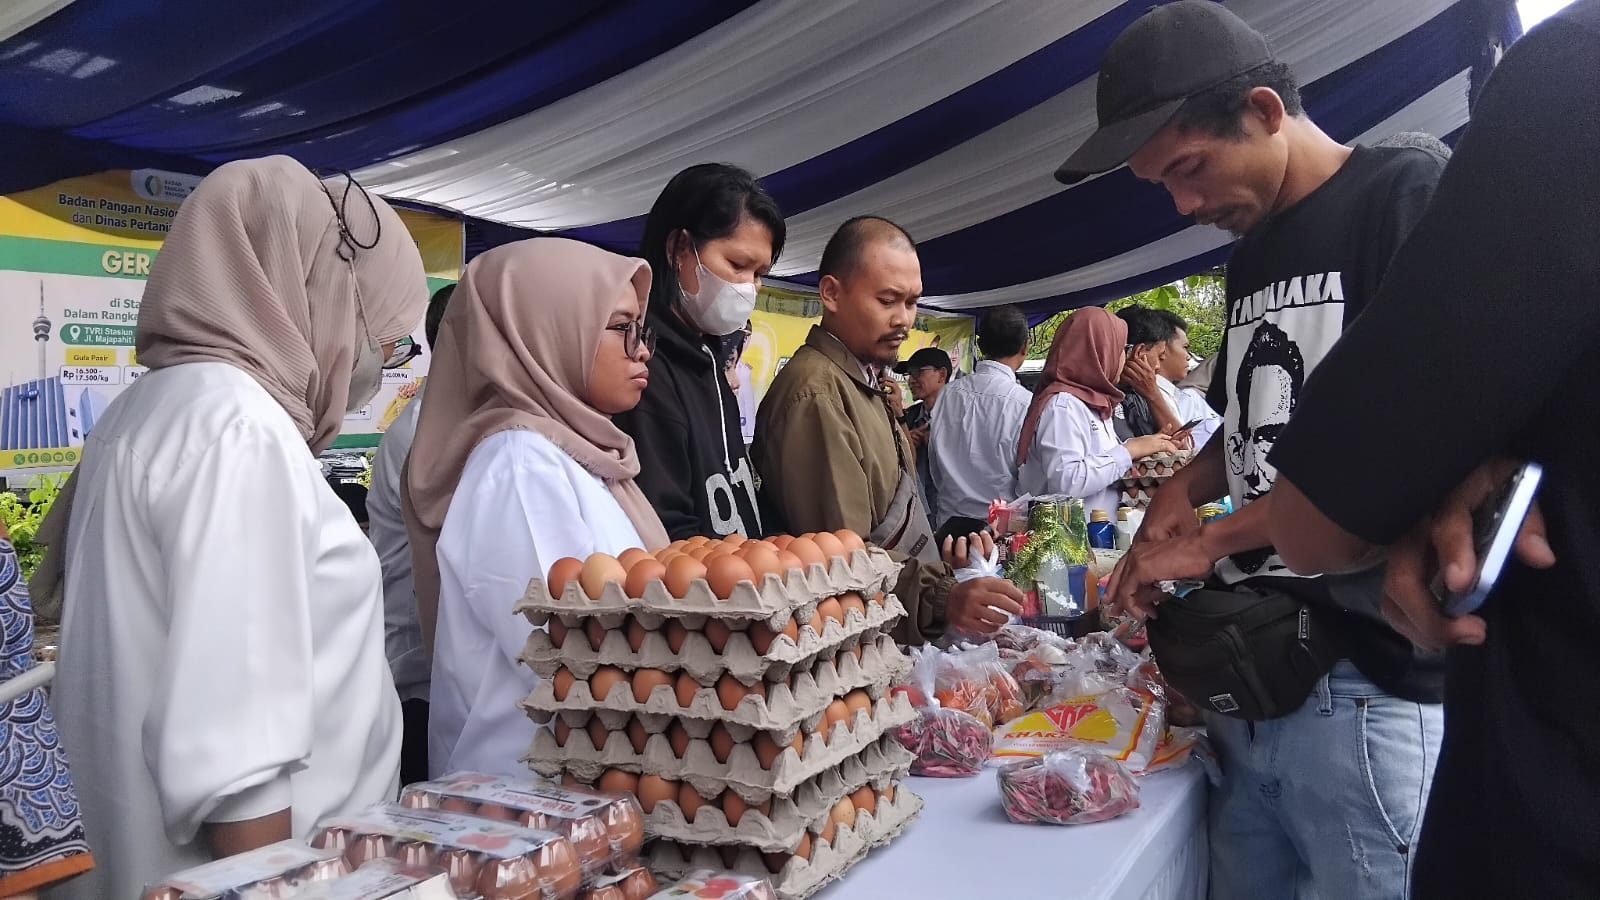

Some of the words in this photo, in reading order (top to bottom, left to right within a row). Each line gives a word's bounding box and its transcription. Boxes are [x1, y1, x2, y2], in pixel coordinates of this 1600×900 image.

[58, 193, 96, 209] Badan
[100, 199, 141, 215] Pangan
[72, 212, 92, 224] dan
[95, 215, 127, 228] Dinas
[102, 250, 151, 275] GER
[110, 298, 120, 308] di
[64, 309, 98, 319] Dalam
[84, 327, 103, 335] TVRI
[105, 328, 133, 336] Stasiun
[95, 336, 132, 345] Majapahit
[63, 371, 75, 381] Rp
